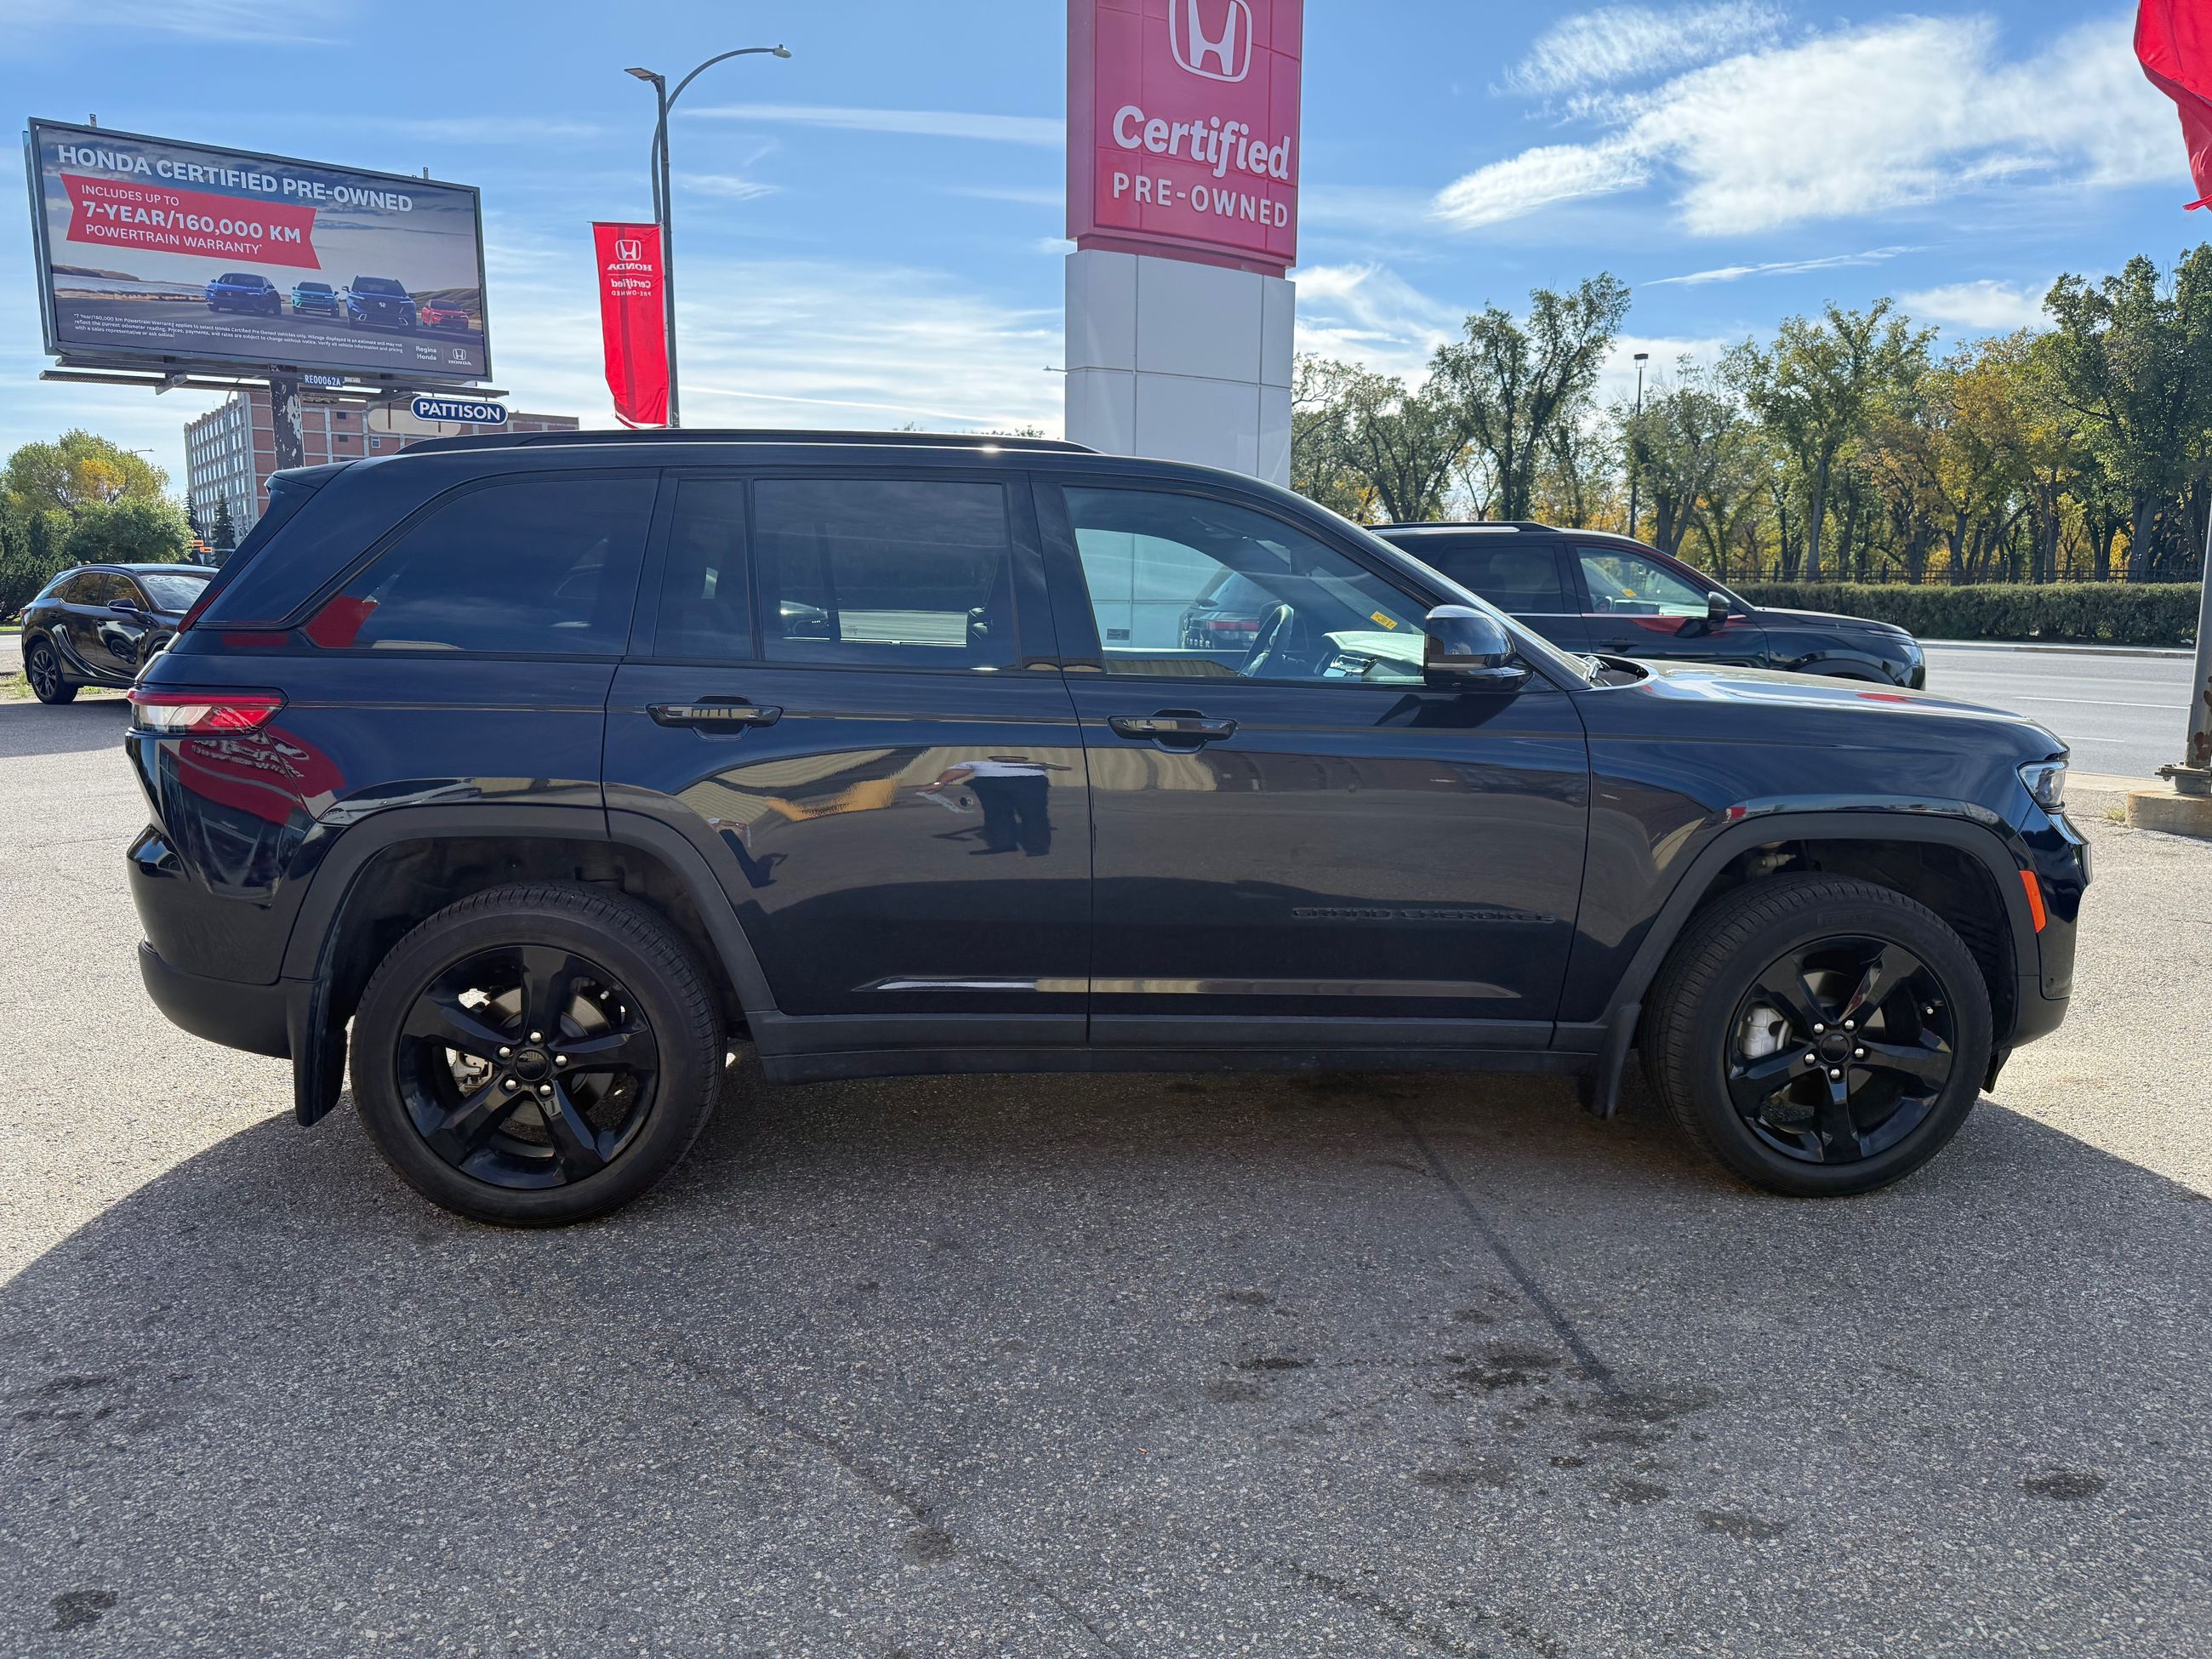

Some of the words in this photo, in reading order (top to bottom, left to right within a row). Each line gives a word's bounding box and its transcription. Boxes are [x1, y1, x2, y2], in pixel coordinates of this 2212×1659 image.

[1112, 105, 1291, 180] Certified
[58, 144, 152, 176] HONDA
[156, 159, 278, 192] CERTIFIED
[282, 178, 413, 212] PRE-OWNED
[82, 185, 142, 202] INCLUDES
[145, 193, 161, 203] UP
[163, 196, 180, 206] TO
[1113, 172, 1288, 228] PRE-OWNED
[83, 201, 263, 239] 7-YEAR/160,000
[270, 225, 301, 243] KM
[86, 224, 180, 245] POWERTRAIN
[305, 374, 341, 386] RE00062A
[419, 401, 501, 421] PATTISON
